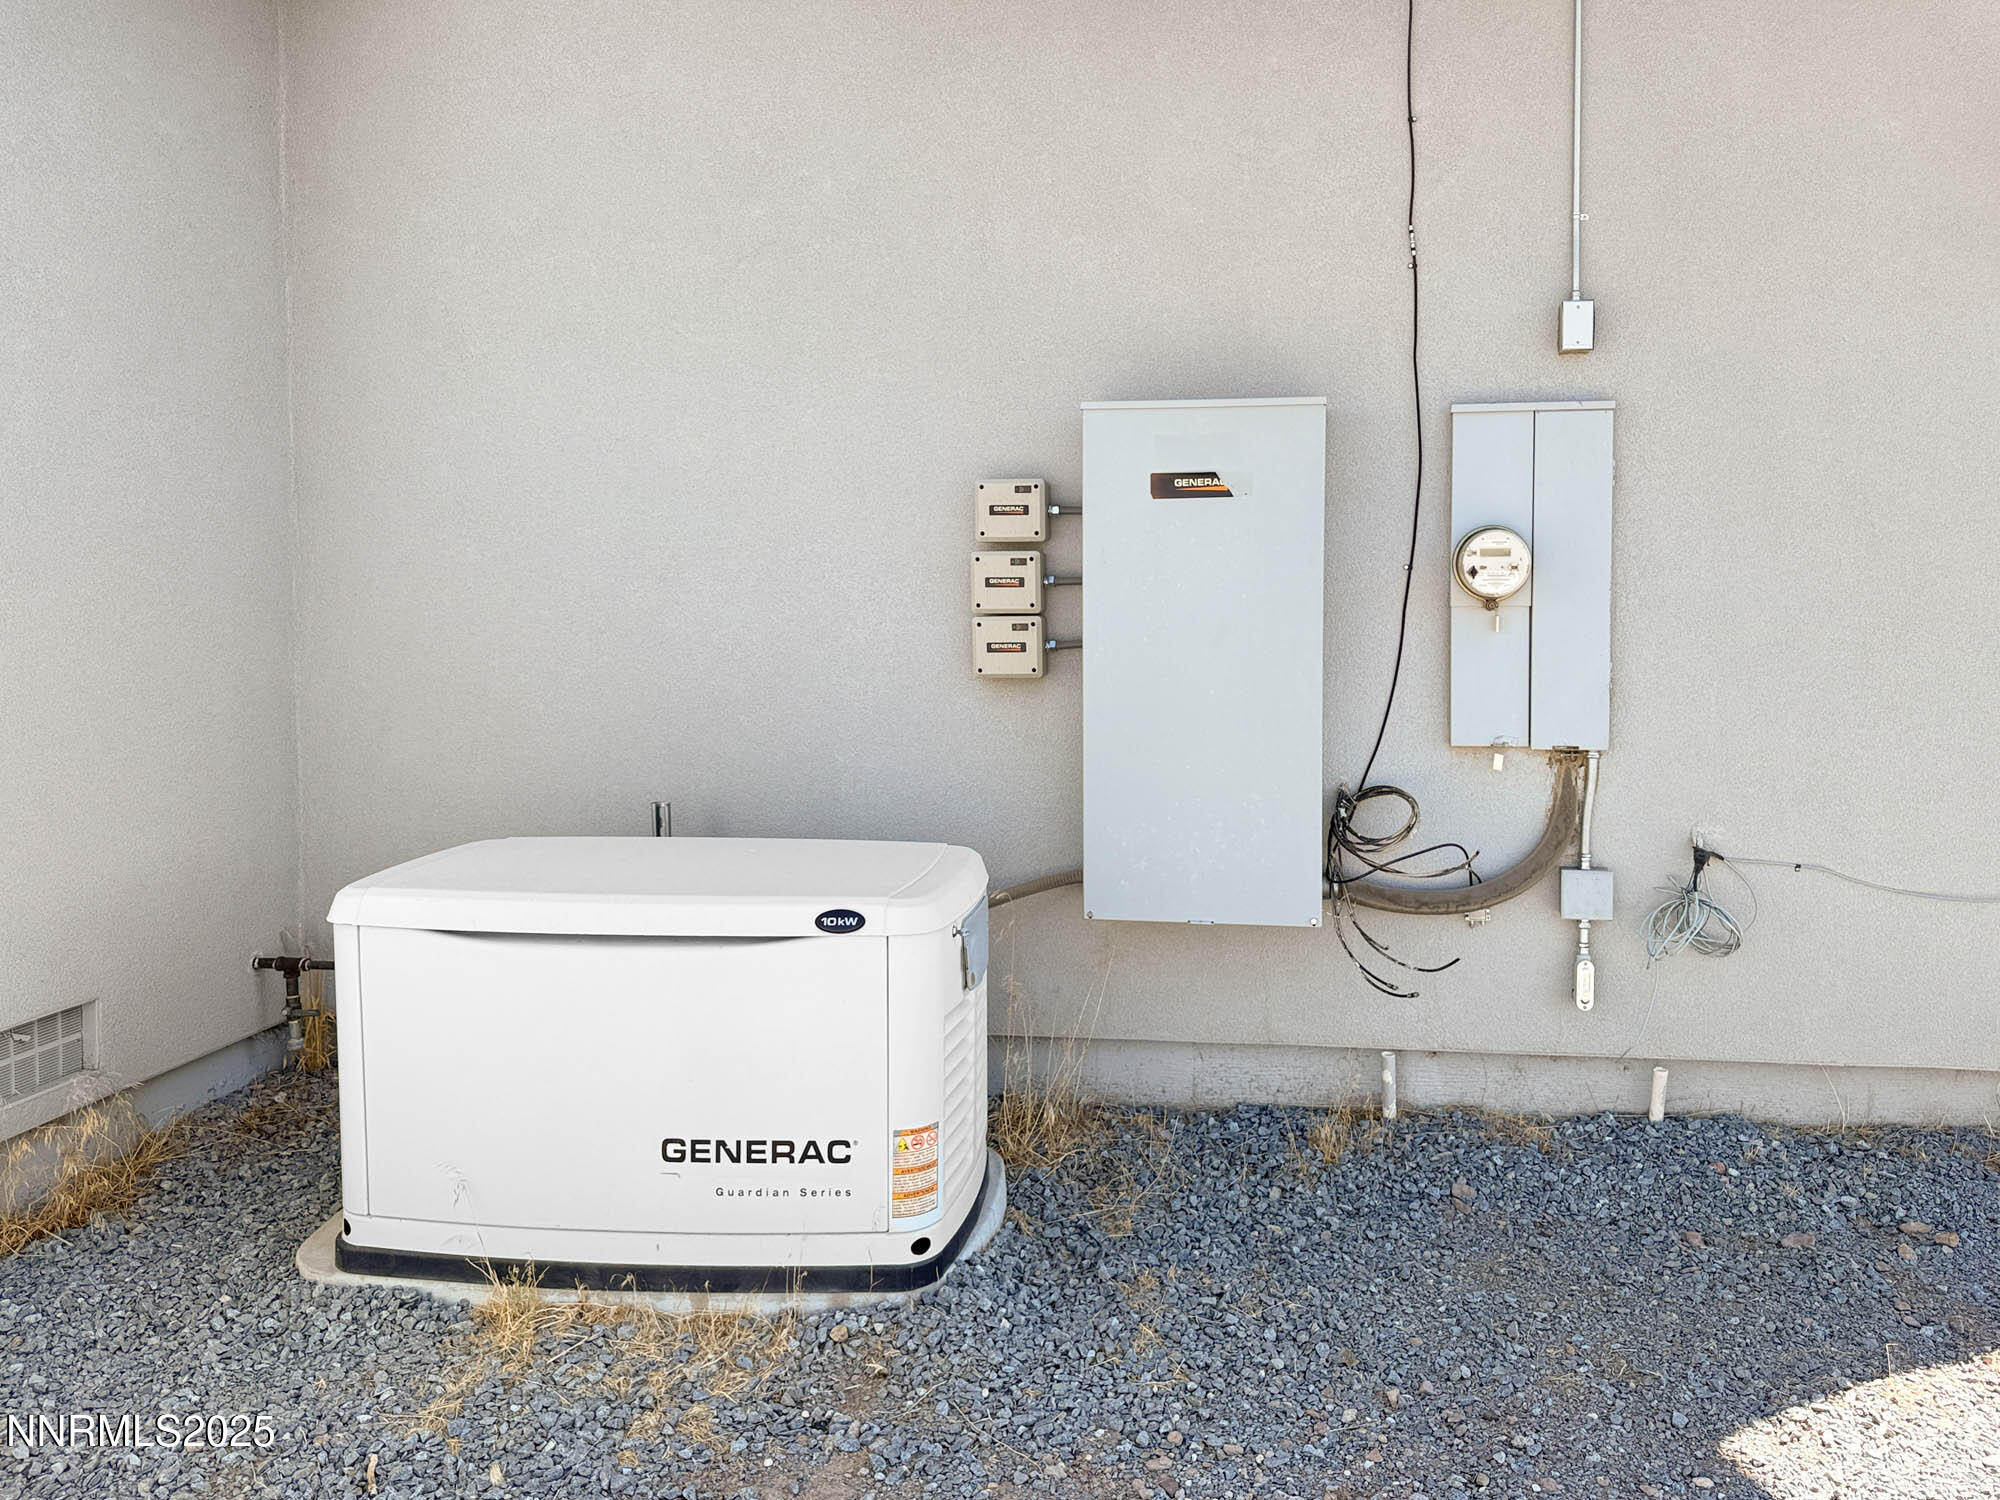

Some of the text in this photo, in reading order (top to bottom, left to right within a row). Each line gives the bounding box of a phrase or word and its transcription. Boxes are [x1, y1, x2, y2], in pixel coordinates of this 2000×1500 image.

[661, 1138, 852, 1164] GENERAC
[715, 1187, 852, 1197] Guardian Series
